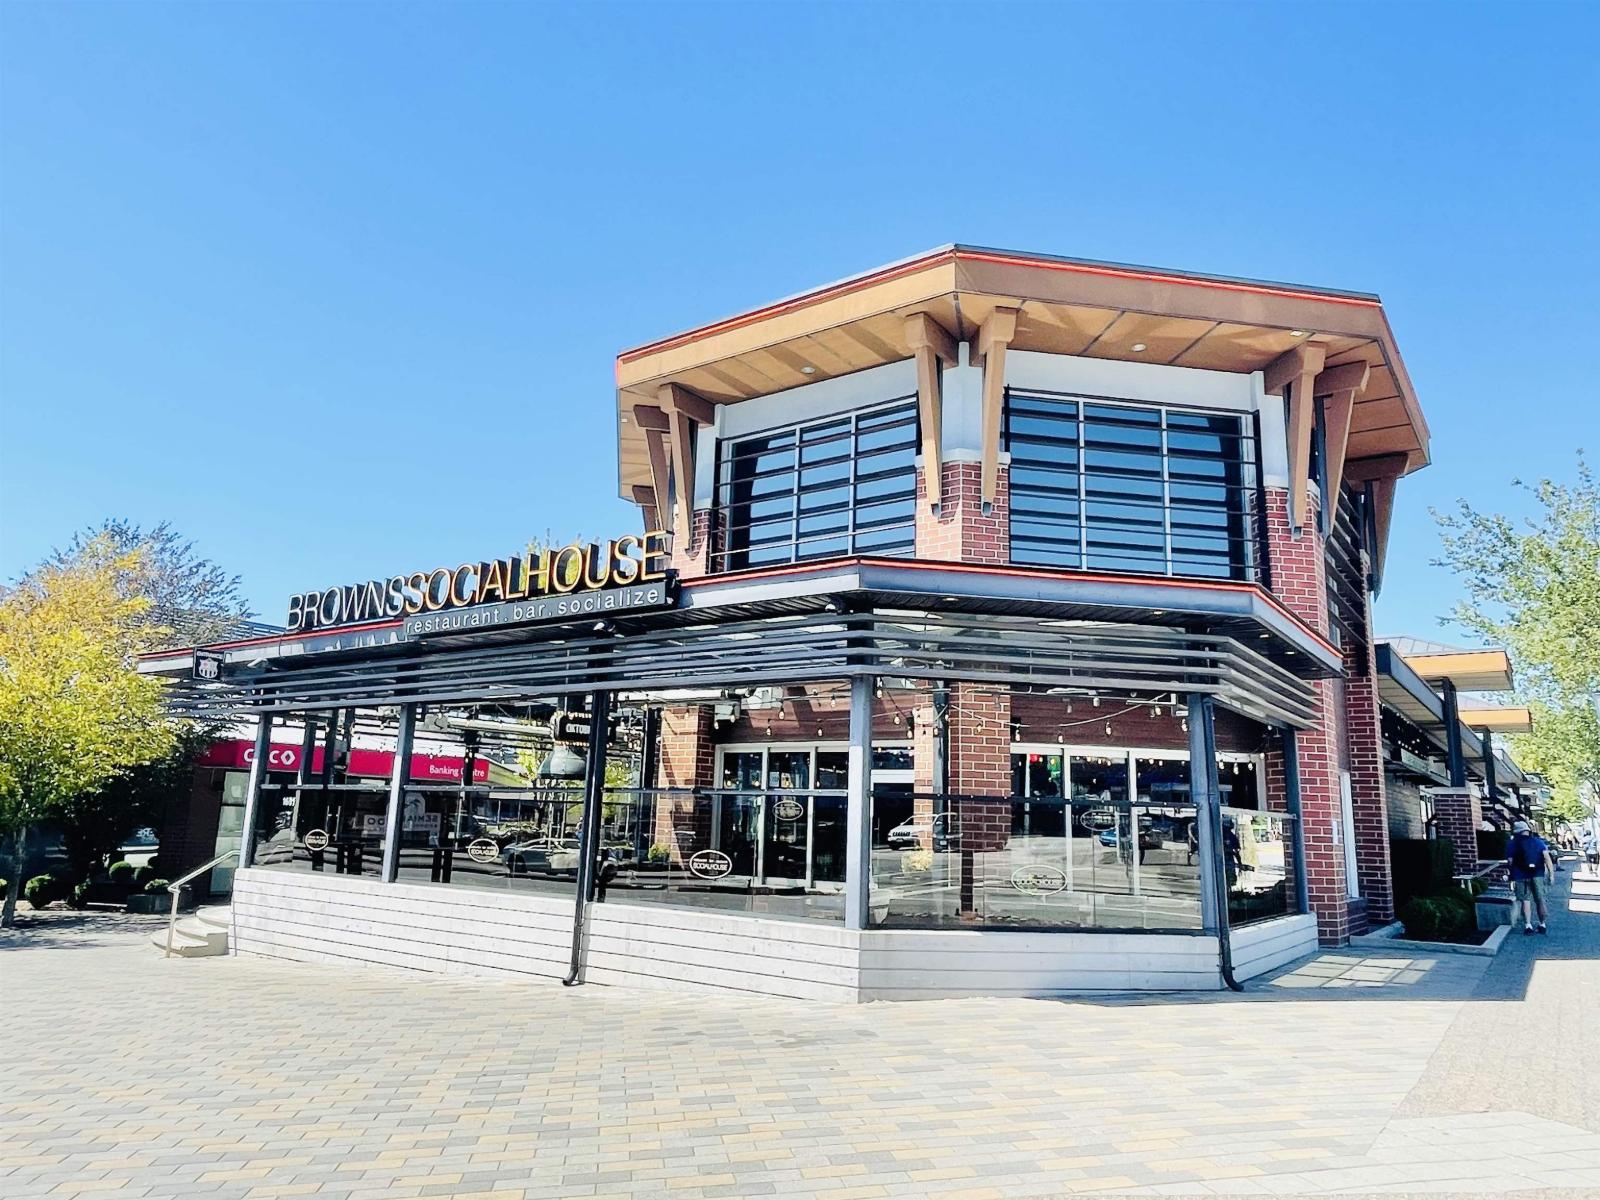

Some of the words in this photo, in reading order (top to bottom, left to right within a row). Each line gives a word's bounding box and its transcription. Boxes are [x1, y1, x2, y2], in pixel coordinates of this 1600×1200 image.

[558, 588, 659, 614] socialize
[429, 764, 459, 778] Banking
[460, 767, 485, 778] Ctre
